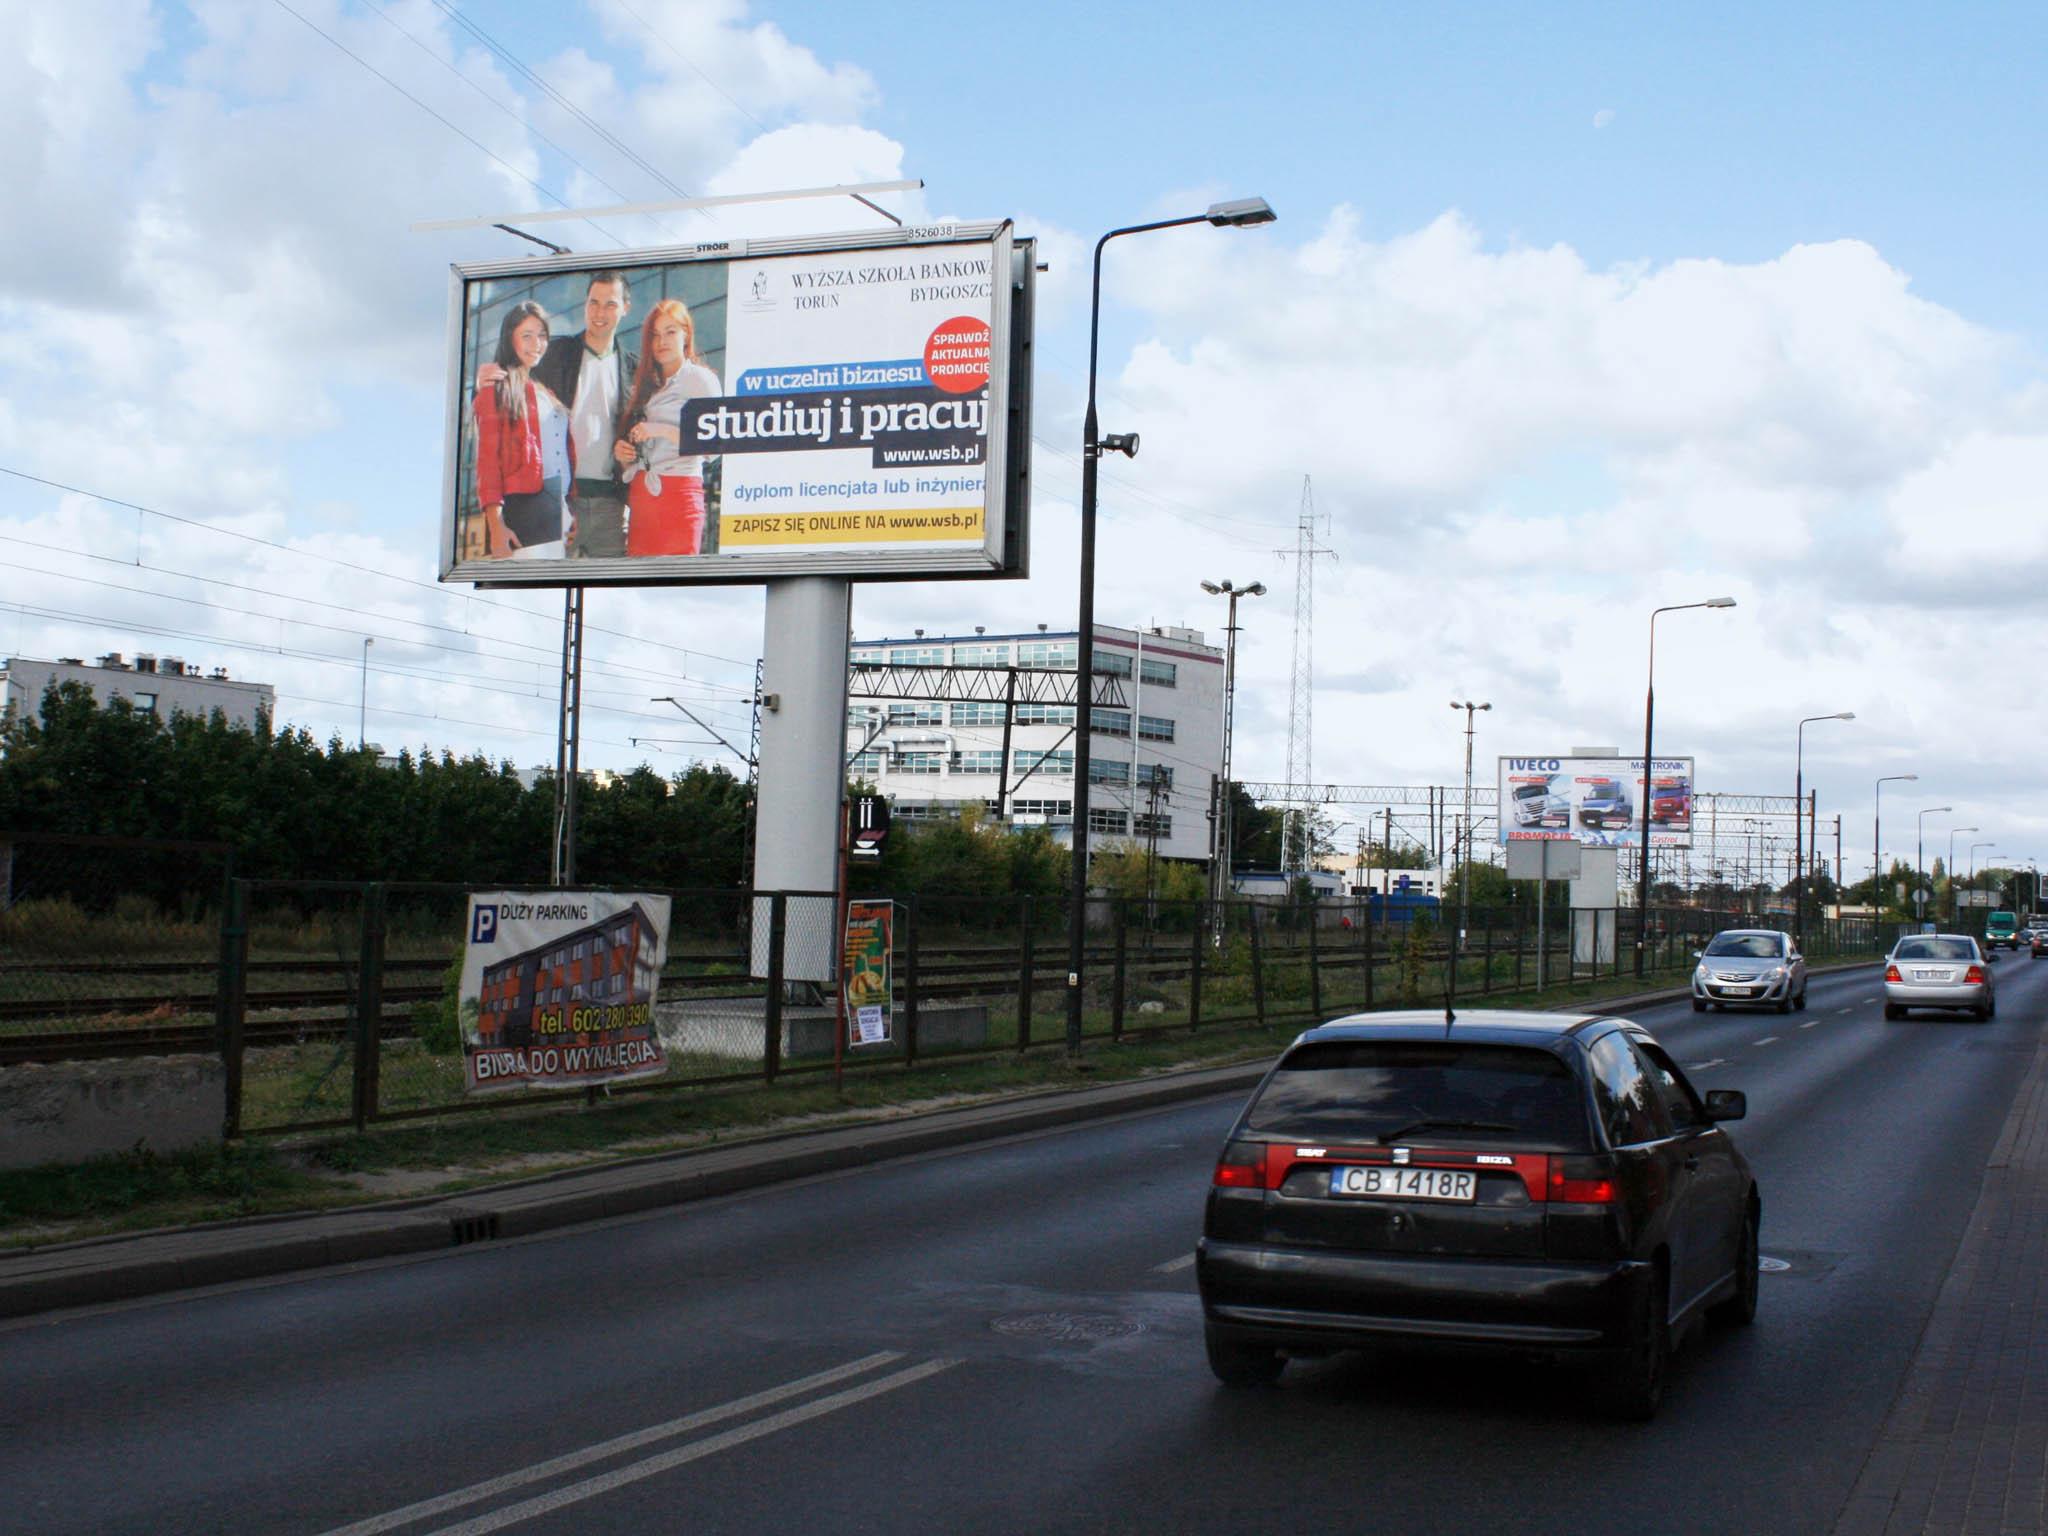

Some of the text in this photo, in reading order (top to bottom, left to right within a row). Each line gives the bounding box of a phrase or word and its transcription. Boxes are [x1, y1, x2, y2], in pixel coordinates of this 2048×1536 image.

[908, 226, 952, 238] 8526038
[791, 268, 855, 288] WYŻSZA
[858, 265, 916, 284] SZKOŁA
[933, 329, 990, 345] SPRAWDŹ
[744, 366, 922, 390] w uczelni biznesu
[697, 390, 988, 442] studiuj i pracuj
[883, 444, 979, 463] www.wsb.pl
[734, 483, 793, 502] dyplom
[799, 480, 878, 499] licencjata
[884, 478, 910, 494] lub
[733, 513, 978, 534] ZAPISZ SIĘ ONLINE NA www.wsb.pl
[1508, 759, 1560, 771] IVECO
[500, 901, 588, 920] DUŻY PARKING
[540, 1010, 567, 1034] tel.
[572, 1008, 601, 1033] 602
[605, 1006, 625, 1030] 280
[475, 1040, 658, 1080] BIURA DO WYNAJĘCIA
[1296, 1148, 1328, 1158] SEAT
[1476, 1155, 1513, 1165] IBIZA
[1347, 1168, 1471, 1198] CB 1418R
